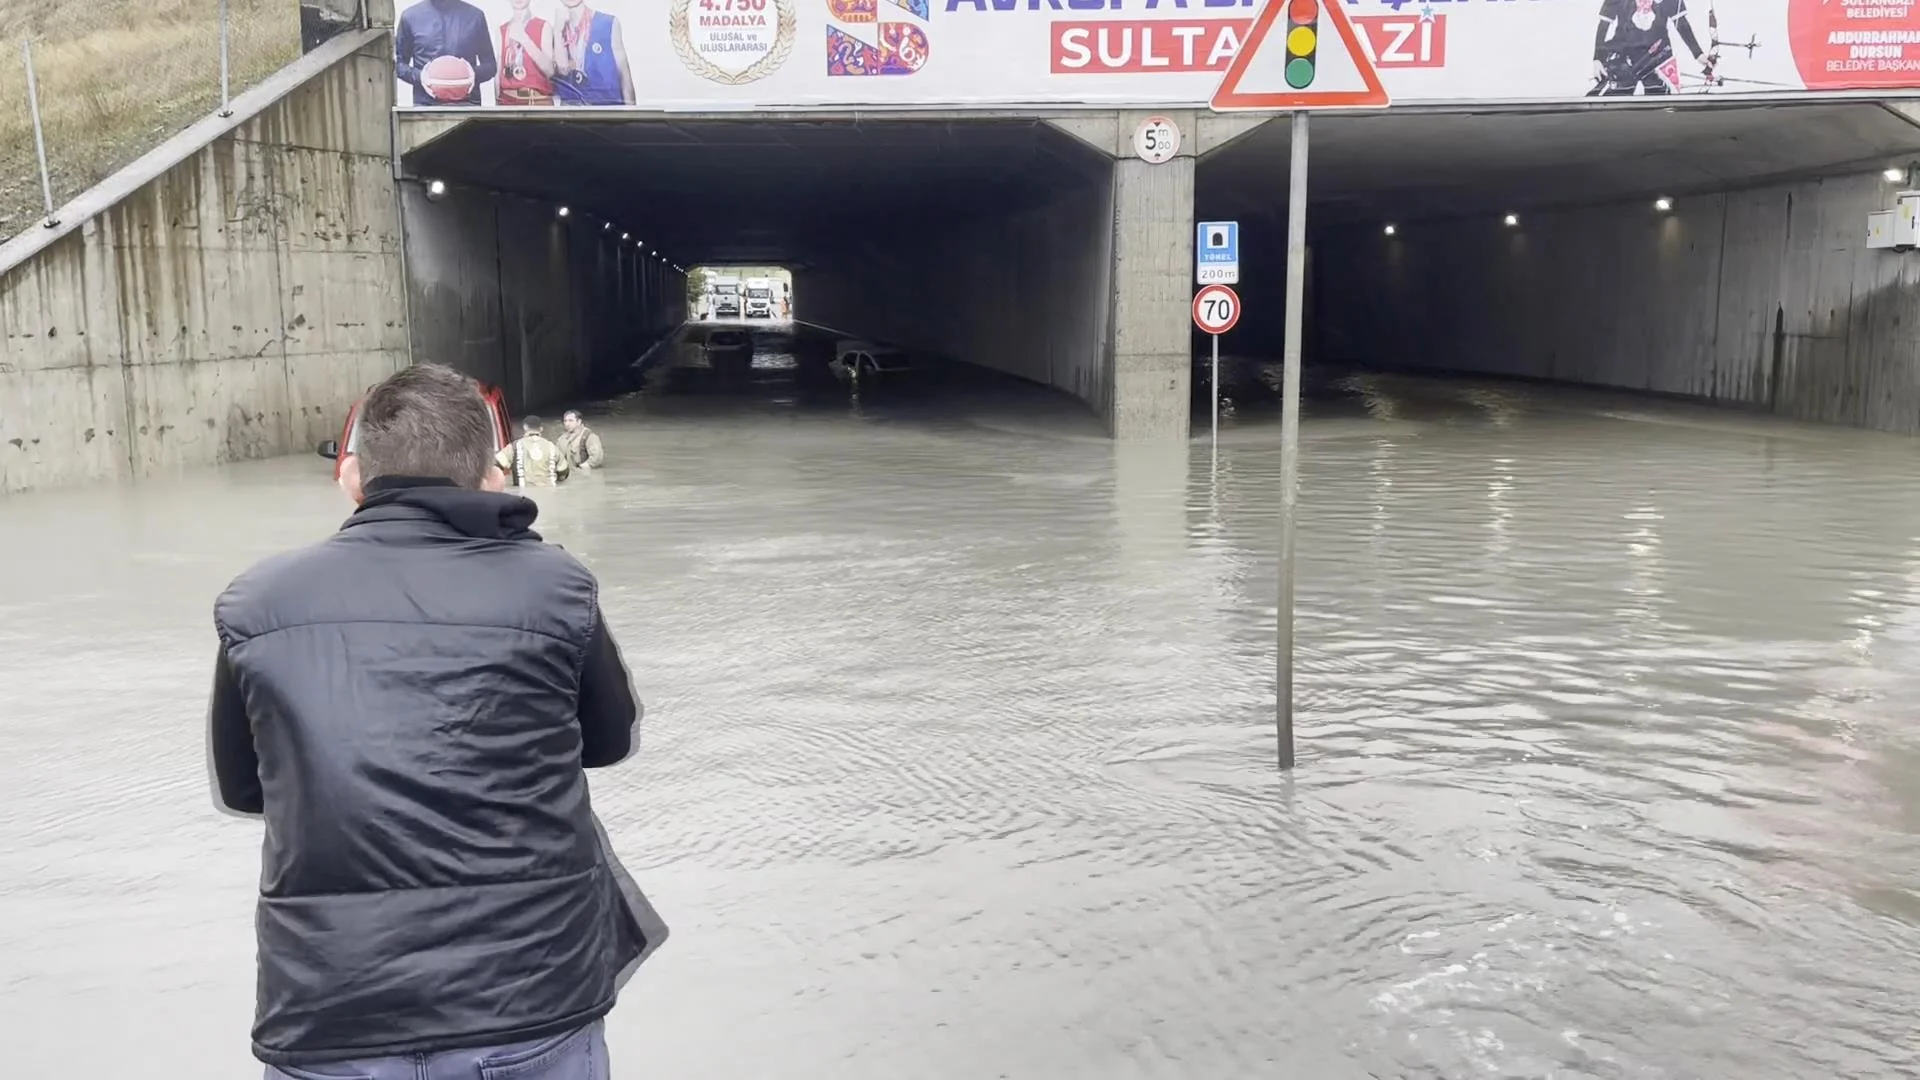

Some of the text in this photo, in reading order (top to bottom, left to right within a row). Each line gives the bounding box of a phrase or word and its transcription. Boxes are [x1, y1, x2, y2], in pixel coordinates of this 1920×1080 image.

[699, 15, 767, 26] MADALYA
[709, 31, 744, 41] ULUSAL
[1849, 45, 1902, 58] DURSUN
[1145, 129, 1156, 150] 5
[1202, 270, 1235, 279] 200m
[1204, 300, 1230, 320] 70
